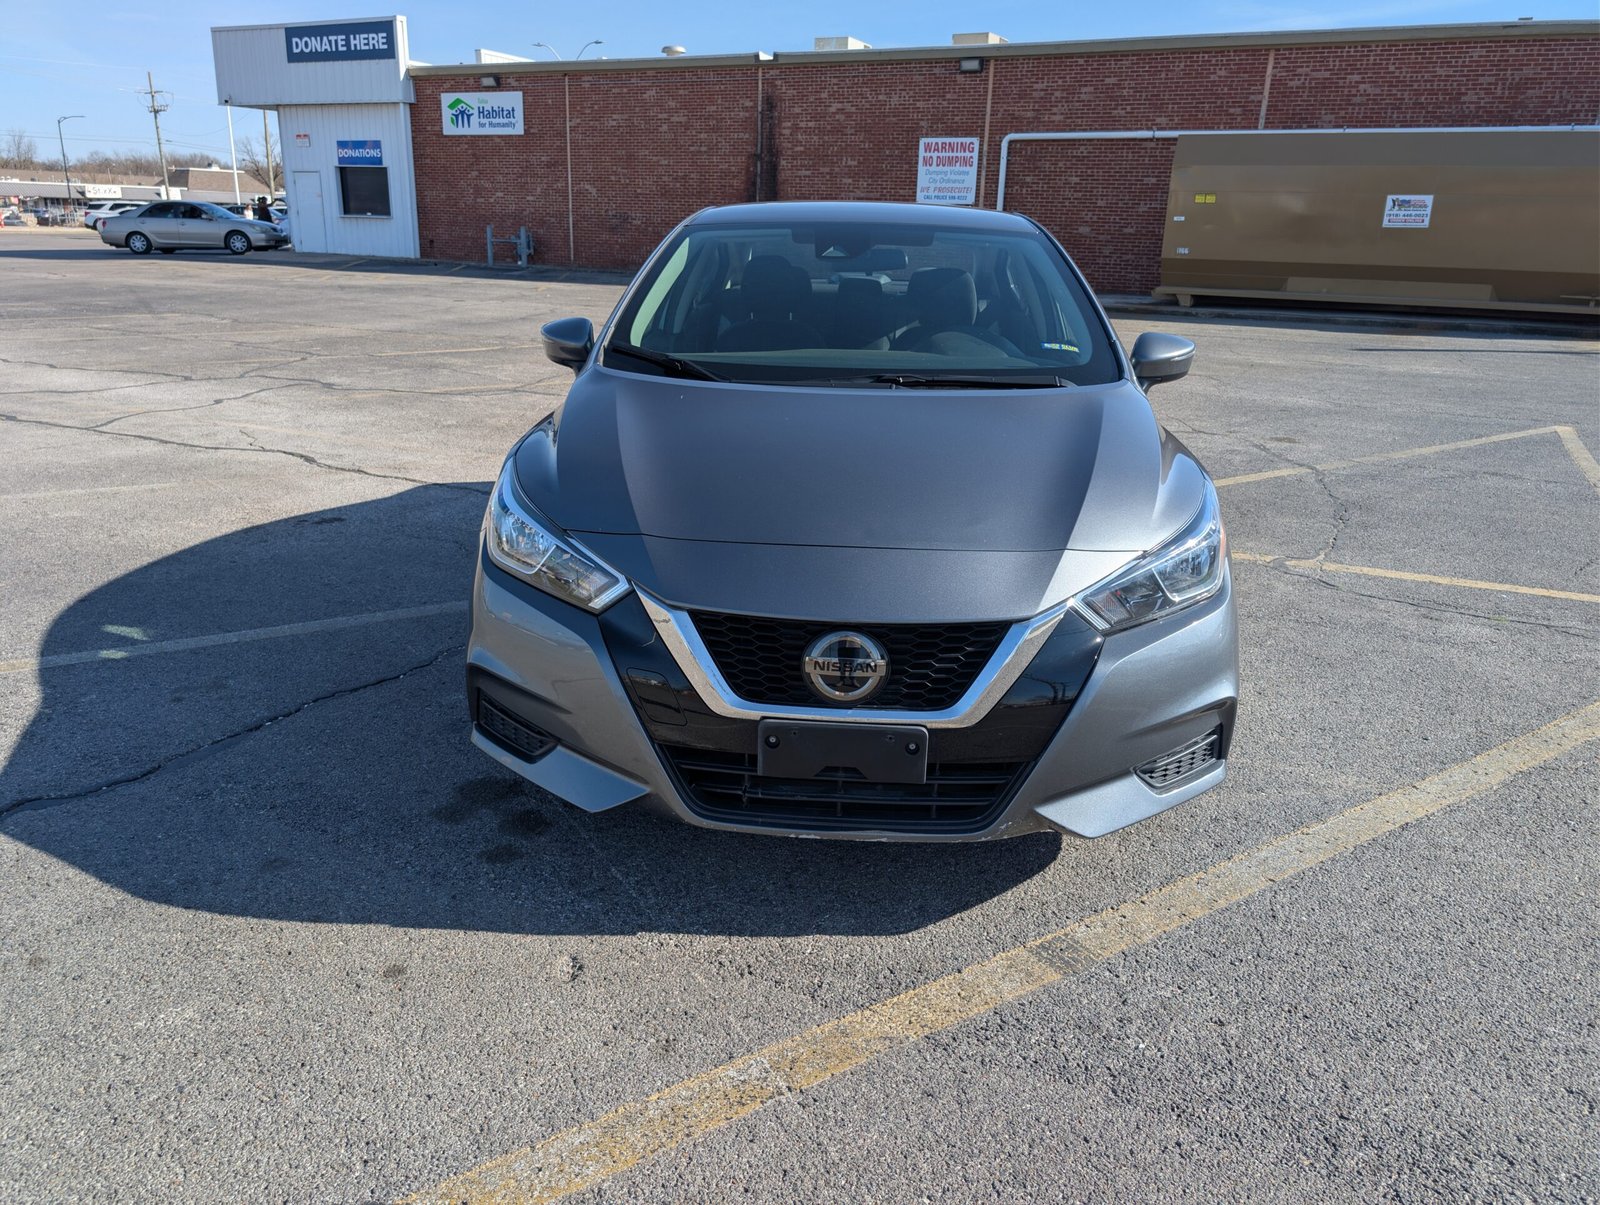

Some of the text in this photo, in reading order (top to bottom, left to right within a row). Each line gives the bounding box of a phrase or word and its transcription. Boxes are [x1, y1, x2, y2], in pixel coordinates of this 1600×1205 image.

[292, 32, 388, 53] DONATE HERE
[477, 105, 516, 120] Habitat
[478, 120, 516, 130] for Humanity
[338, 148, 382, 158] DONATIONS
[923, 141, 975, 154] WARNING
[922, 155, 974, 167] NO DUMPING
[924, 169, 948, 177] Dumping
[933, 186, 972, 194] PROSECUTE!
[813, 660, 878, 673] NISSAN
